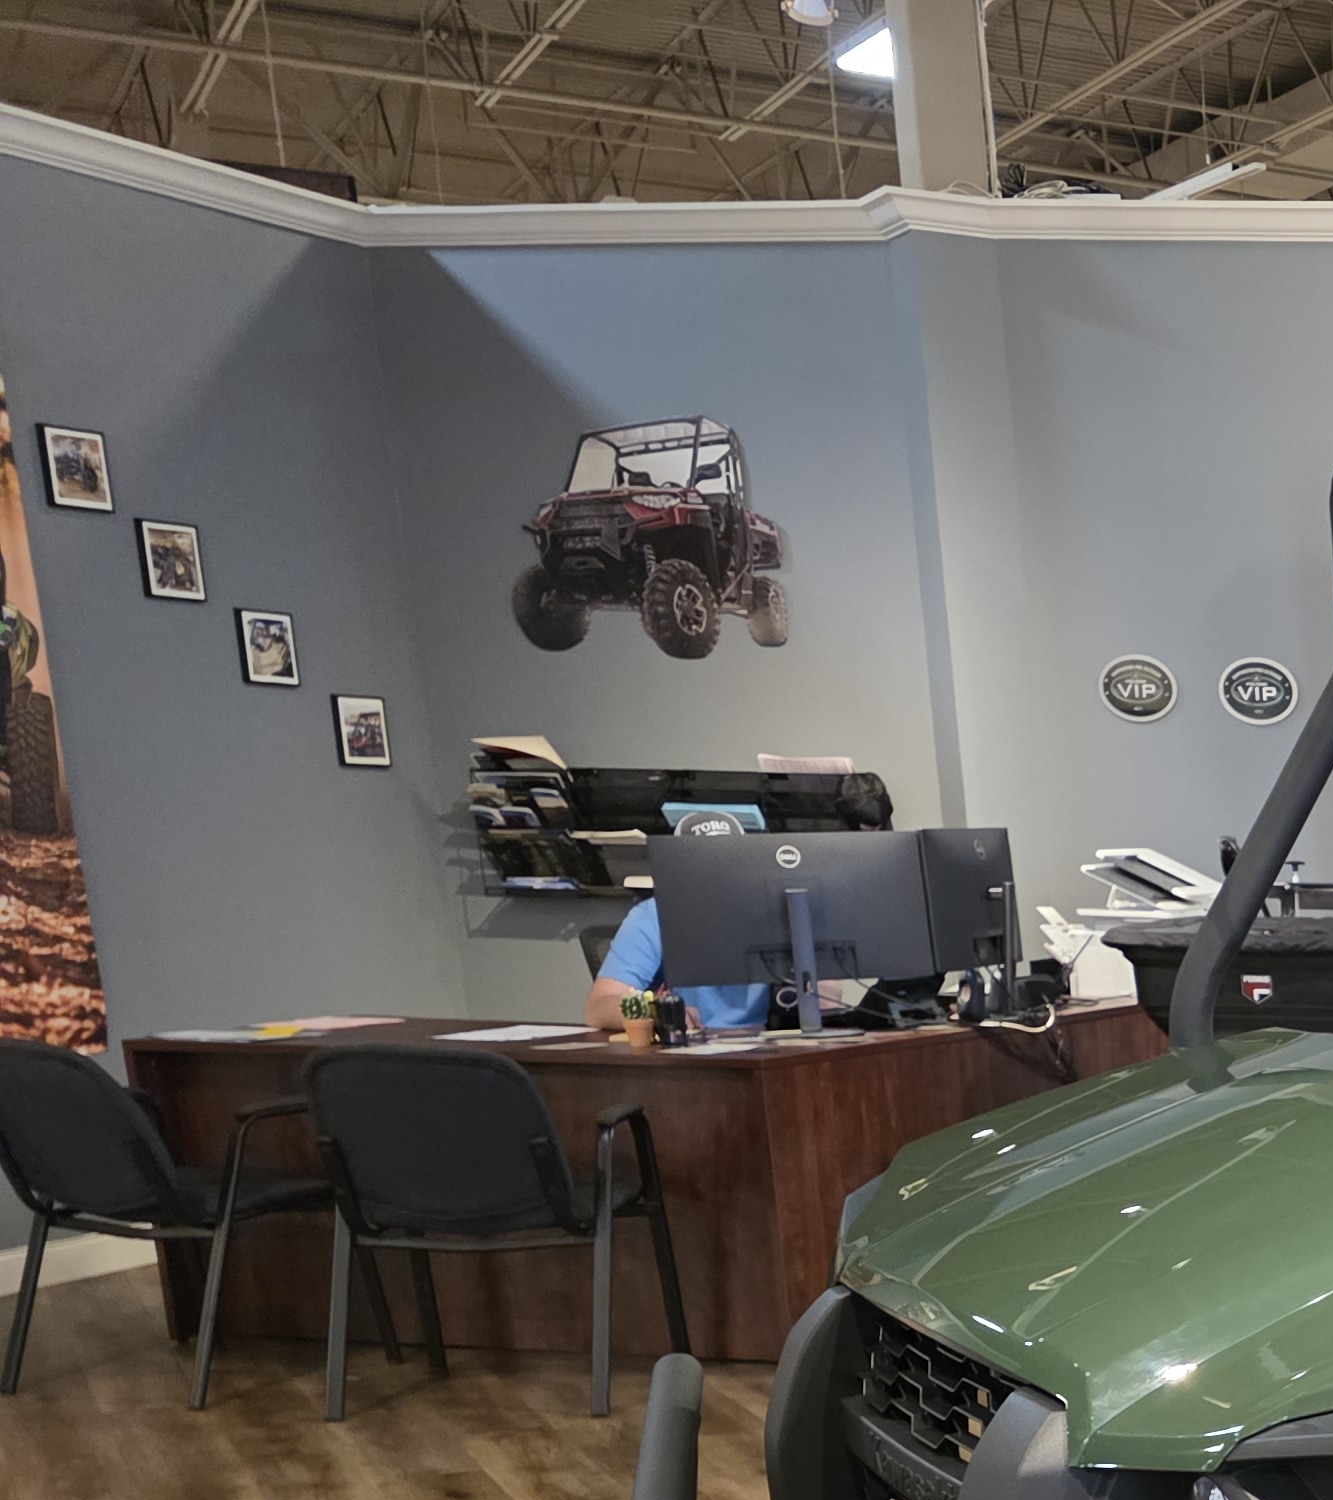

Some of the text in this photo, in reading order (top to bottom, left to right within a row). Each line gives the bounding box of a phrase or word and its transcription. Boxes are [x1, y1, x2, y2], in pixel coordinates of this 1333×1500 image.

[1116, 683, 1156, 699] VIP
[1237, 685, 1278, 702] VIP
[690, 820, 731, 836] TORO
